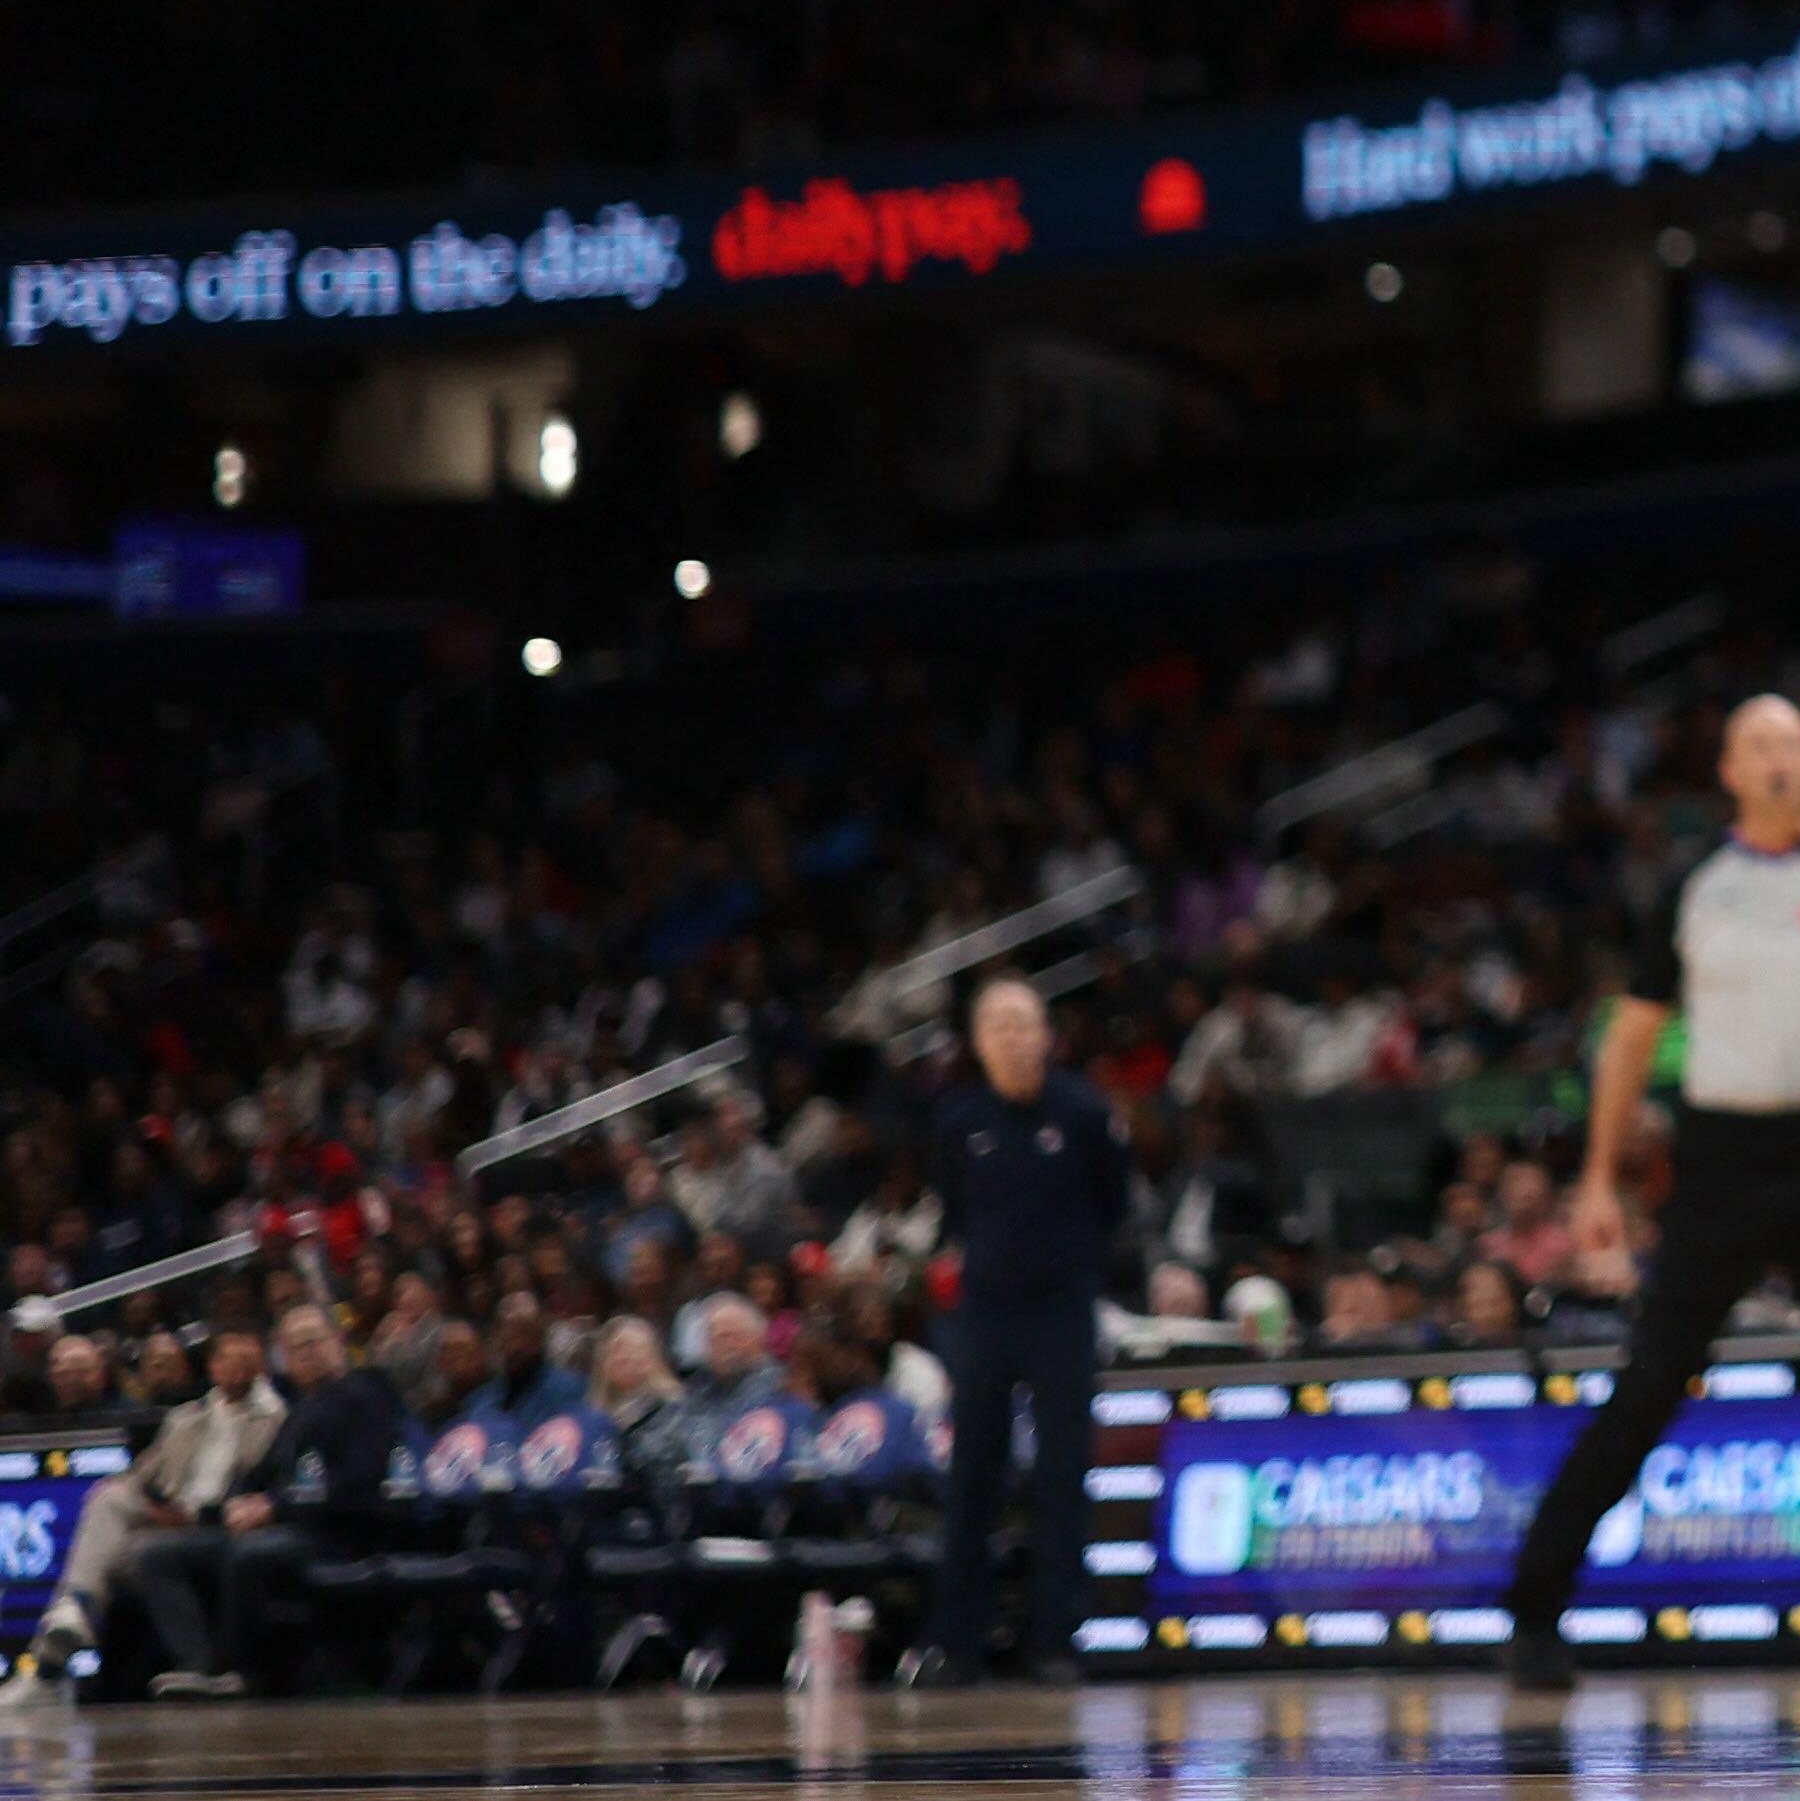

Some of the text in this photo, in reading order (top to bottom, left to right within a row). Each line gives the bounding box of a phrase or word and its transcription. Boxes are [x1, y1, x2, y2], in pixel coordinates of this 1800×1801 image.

[5, 255, 182, 346] pays
[184, 228, 297, 322] off
[298, 245, 400, 318] on
[408, 220, 517, 313] the
